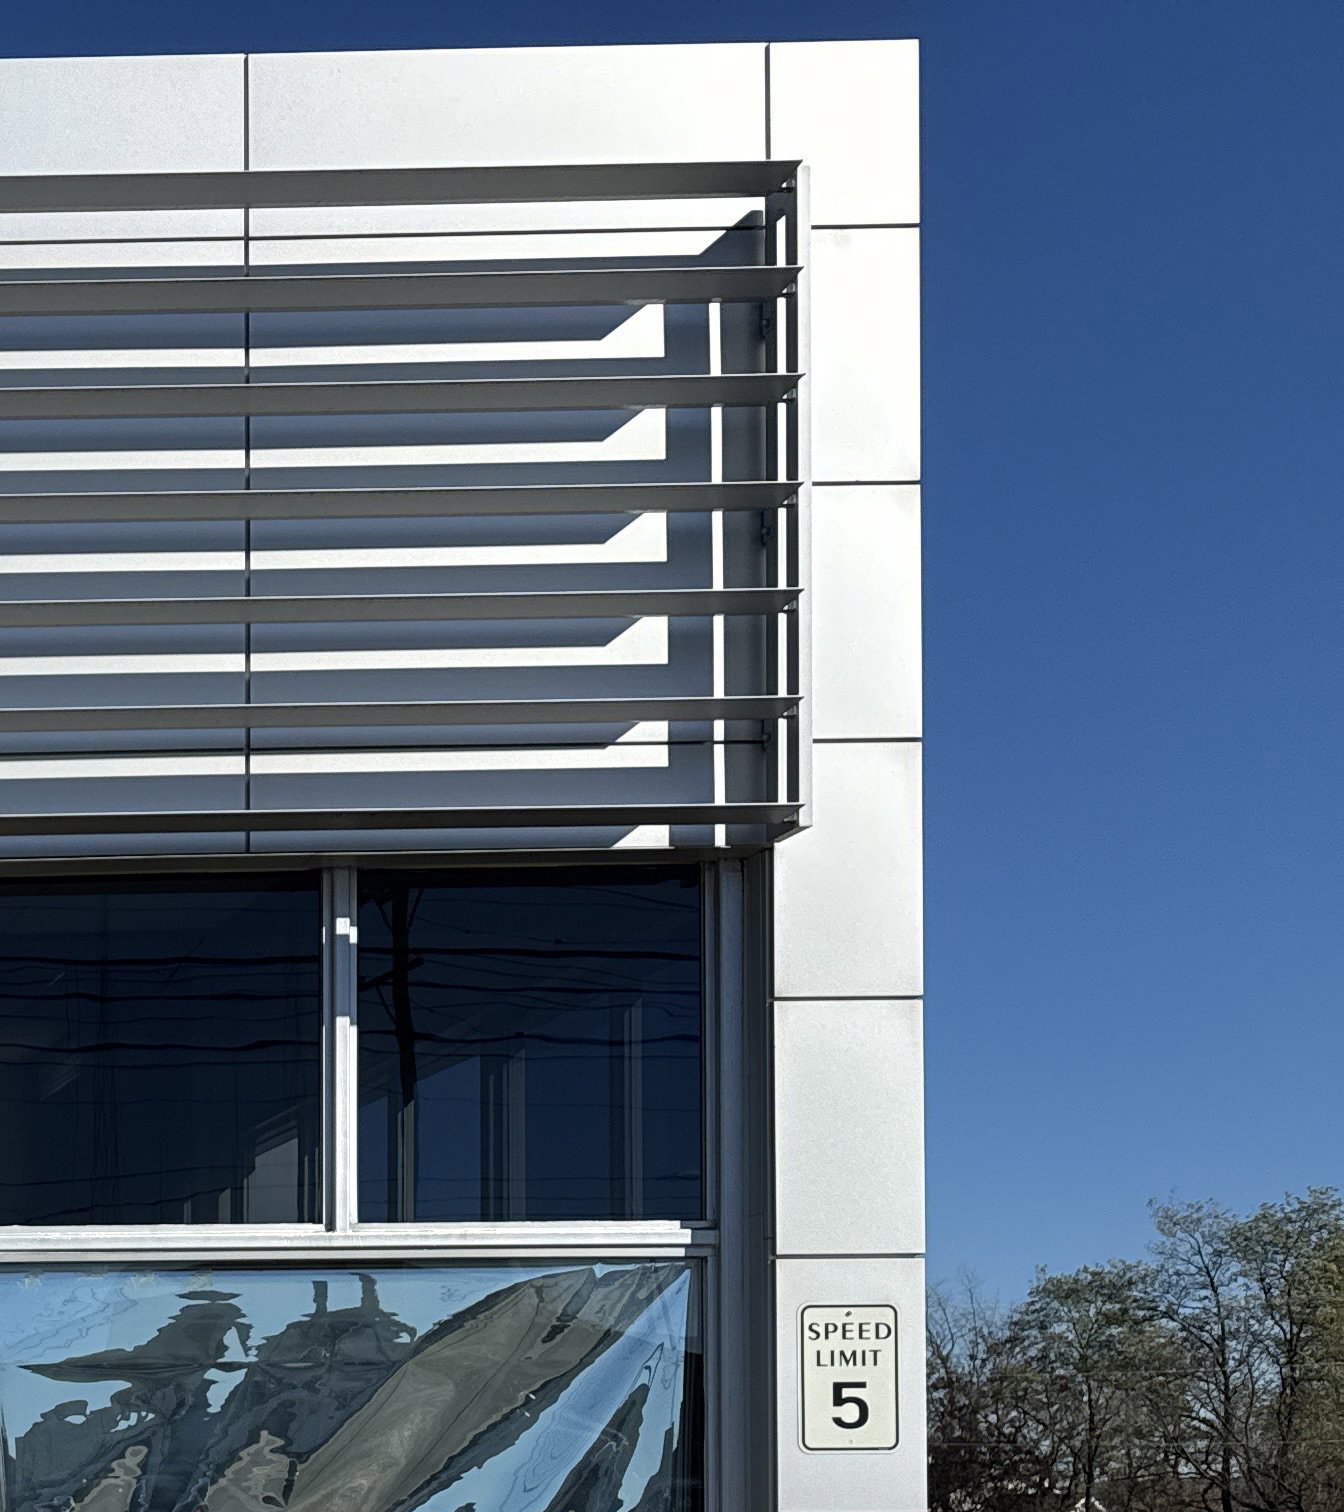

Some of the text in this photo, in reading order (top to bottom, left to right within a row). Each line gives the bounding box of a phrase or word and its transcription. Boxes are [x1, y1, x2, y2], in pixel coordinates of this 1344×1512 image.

[808, 1322, 892, 1341] SPEED
[816, 1349, 882, 1367] LIMIT
[831, 1381, 870, 1430] 5
